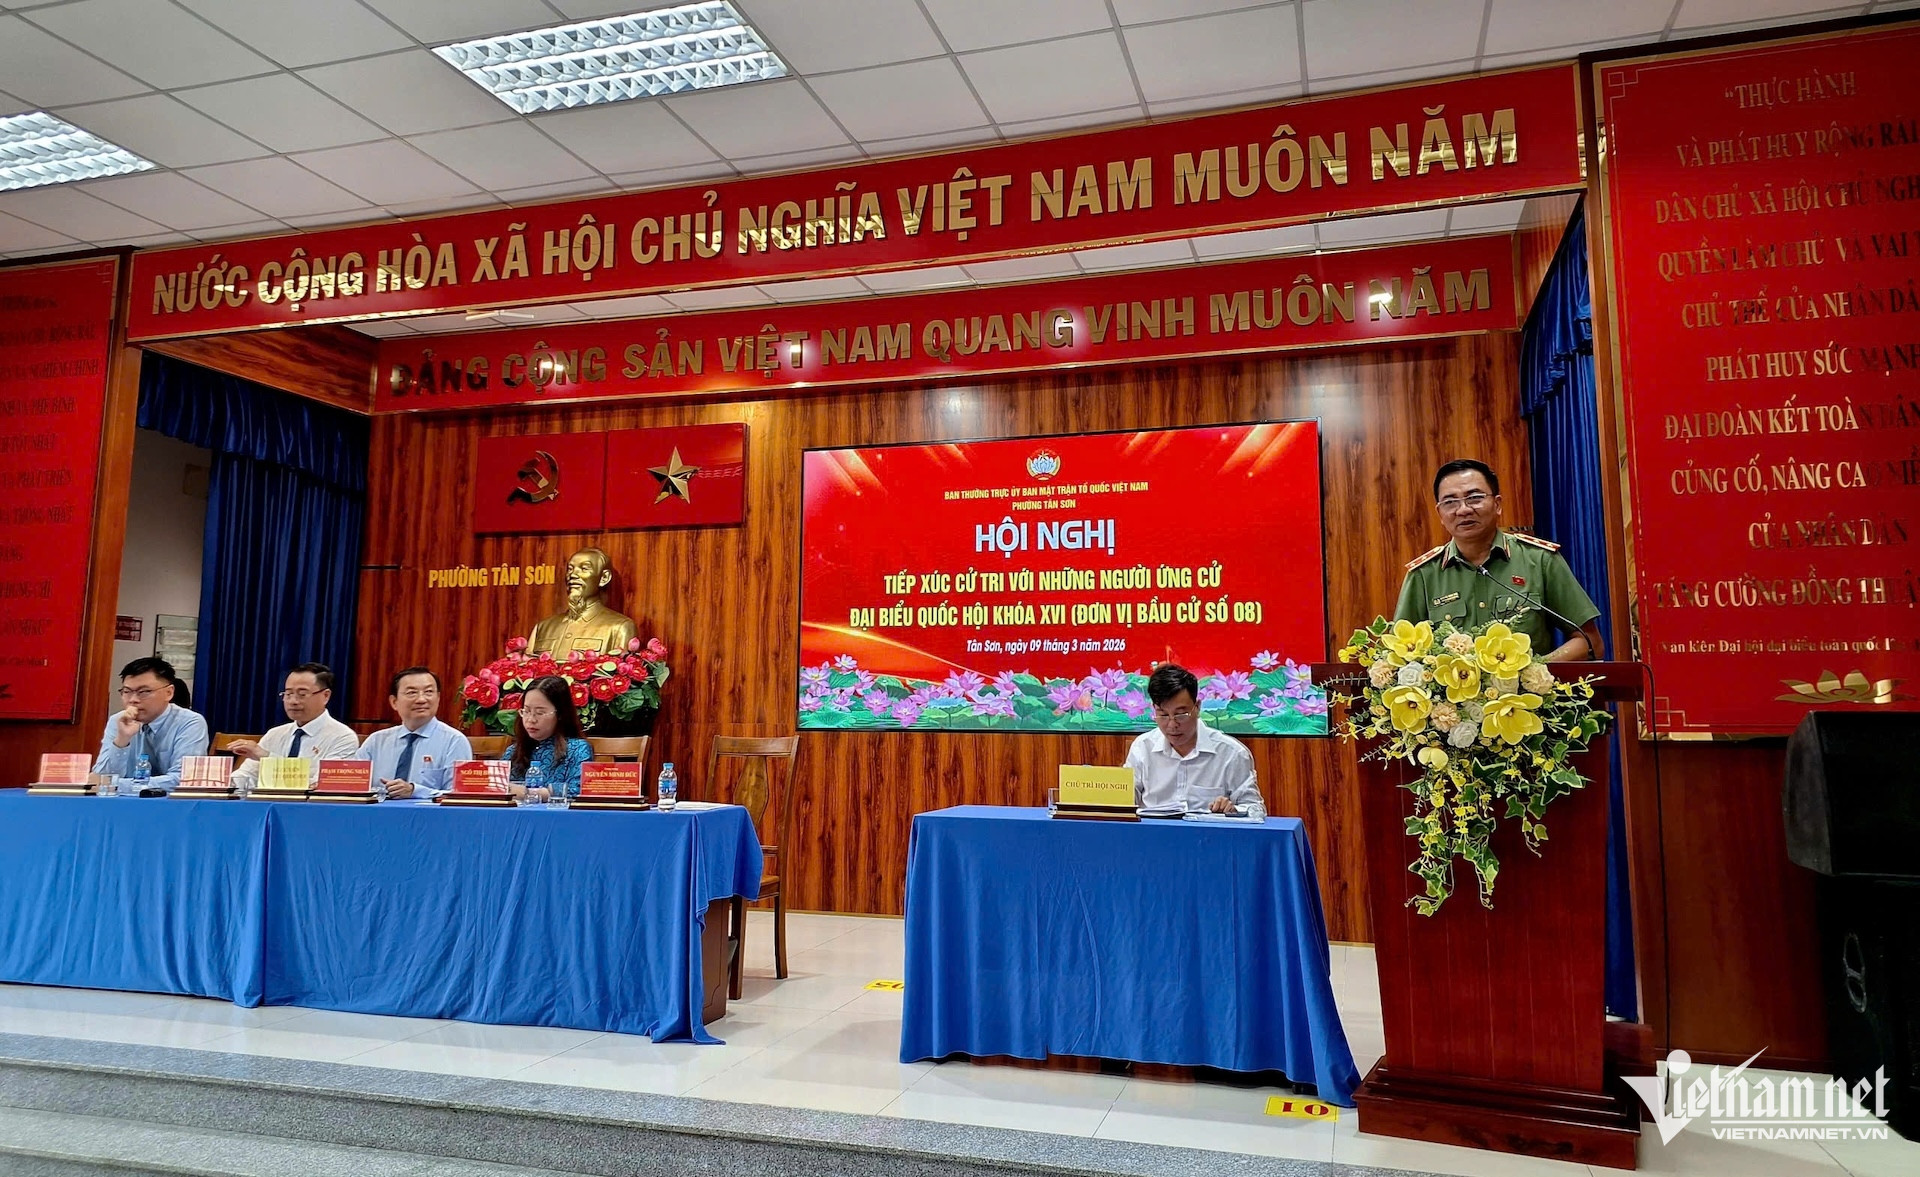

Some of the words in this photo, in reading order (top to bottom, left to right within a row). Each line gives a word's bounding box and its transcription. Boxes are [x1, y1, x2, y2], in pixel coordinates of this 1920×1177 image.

[1676, 136, 1704, 168] VÀ
[1708, 130, 1761, 166] PHÁT
[1766, 131, 1808, 159] HUY
[152, 253, 249, 316] NƯỚC
[257, 247, 365, 313] CỘNG
[375, 242, 457, 294] HÒA
[471, 222, 530, 284] XÃ
[541, 213, 615, 276] HỘI
[630, 190, 724, 265] CHỦ
[737, 181, 886, 256] NGHĨA
[896, 167, 1012, 243] VIỆT
[1030, 156, 1155, 222] NAM
[1173, 123, 1350, 207] MUÔN
[1368, 103, 1518, 182] NĂM
[1655, 192, 1699, 224] DÂN
[1702, 183, 1744, 220] CHỦ
[1749, 182, 1778, 215] XÃ
[1782, 178, 1821, 215] HỘI
[1658, 234, 1726, 282] QUYỀN
[1732, 239, 1777, 272] LÀM
[1682, 290, 1722, 329] CHỦ
[1775, 286, 1820, 321] CỦA
[391, 347, 490, 399] ĐẢNG
[501, 339, 607, 393] CỘNG
[621, 327, 705, 380] SẢN
[718, 323, 808, 379] VIỆT
[820, 320, 913, 367] NAM
[921, 307, 1076, 362] QUANG
[1083, 295, 1196, 345] VINH
[1208, 273, 1357, 333] MUÔN
[1367, 264, 1493, 323] NĂM
[1706, 347, 1760, 382] PHÁT
[1766, 350, 1808, 380] HUY
[1813, 340, 1853, 376] SỨC
[1664, 413, 1701, 444] ĐẠI
[1706, 402, 1763, 437] ĐOÀN
[1767, 394, 1811, 434] KẾT
[944, 490, 960, 500] BAN
[961, 488, 990, 499] THƯỜNG
[991, 487, 1010, 499] TRỰC
[1022, 487, 1038, 497] BAN
[1057, 484, 1077, 497] TRẬN
[1089, 482, 1110, 495] QUỐC
[1112, 481, 1128, 494] VIỆT
[1130, 482, 1149, 492] NAM
[1671, 459, 1728, 495] CỦNG
[1733, 453, 1769, 496] CỐ,
[1771, 456, 1831, 491] NÂNG
[1012, 499, 1042, 511] PHƯỜNG
[1044, 499, 1059, 509] TÂN
[1060, 498, 1076, 509] SƠN
[975, 515, 1028, 559] HỘI
[1037, 518, 1116, 556] NGHỊ
[1748, 512, 1792, 549] CỦA
[428, 564, 488, 589] PHƯỜNG
[492, 562, 520, 586] TÂN
[524, 562, 556, 585] SƠN
[884, 568, 917, 594] TIẾP
[920, 570, 950, 593] XÚC
[955, 567, 978, 593] CỬ
[980, 572, 1004, 592] TRI
[1008, 567, 1034, 592] VỚI
[1039, 566, 1095, 591] NHỮNG
[1100, 564, 1151, 590] NGƯỜI
[1156, 563, 1192, 588] ỨNG
[1197, 560, 1222, 588] CỬ
[850, 607, 875, 631] ĐẠI
[879, 600, 913, 627] BIỂU
[917, 600, 958, 629] QUỐC
[962, 602, 988, 630] HỘI
[993, 601, 1036, 625] KHÓA
[1040, 604, 1066, 625] XVI
[1071, 601, 1112, 626] (ĐƠN
[1116, 603, 1132, 628] VỊ
[1137, 596, 1171, 624] BẦU
[1176, 595, 1201, 623] CỬ
[1204, 594, 1229, 623] SỐ
[1233, 601, 1262, 625] 08)
[966, 639, 983, 652] Tân
[984, 639, 1003, 653] Sơn,
[1004, 638, 1028, 655] ngày
[1029, 639, 1042, 652] 09
[1043, 638, 1070, 655] tháng
[1071, 639, 1078, 652] 3
[1079, 638, 1101, 652] năm
[1102, 638, 1126, 652] 2026
[1719, 639, 1741, 655] Đại
